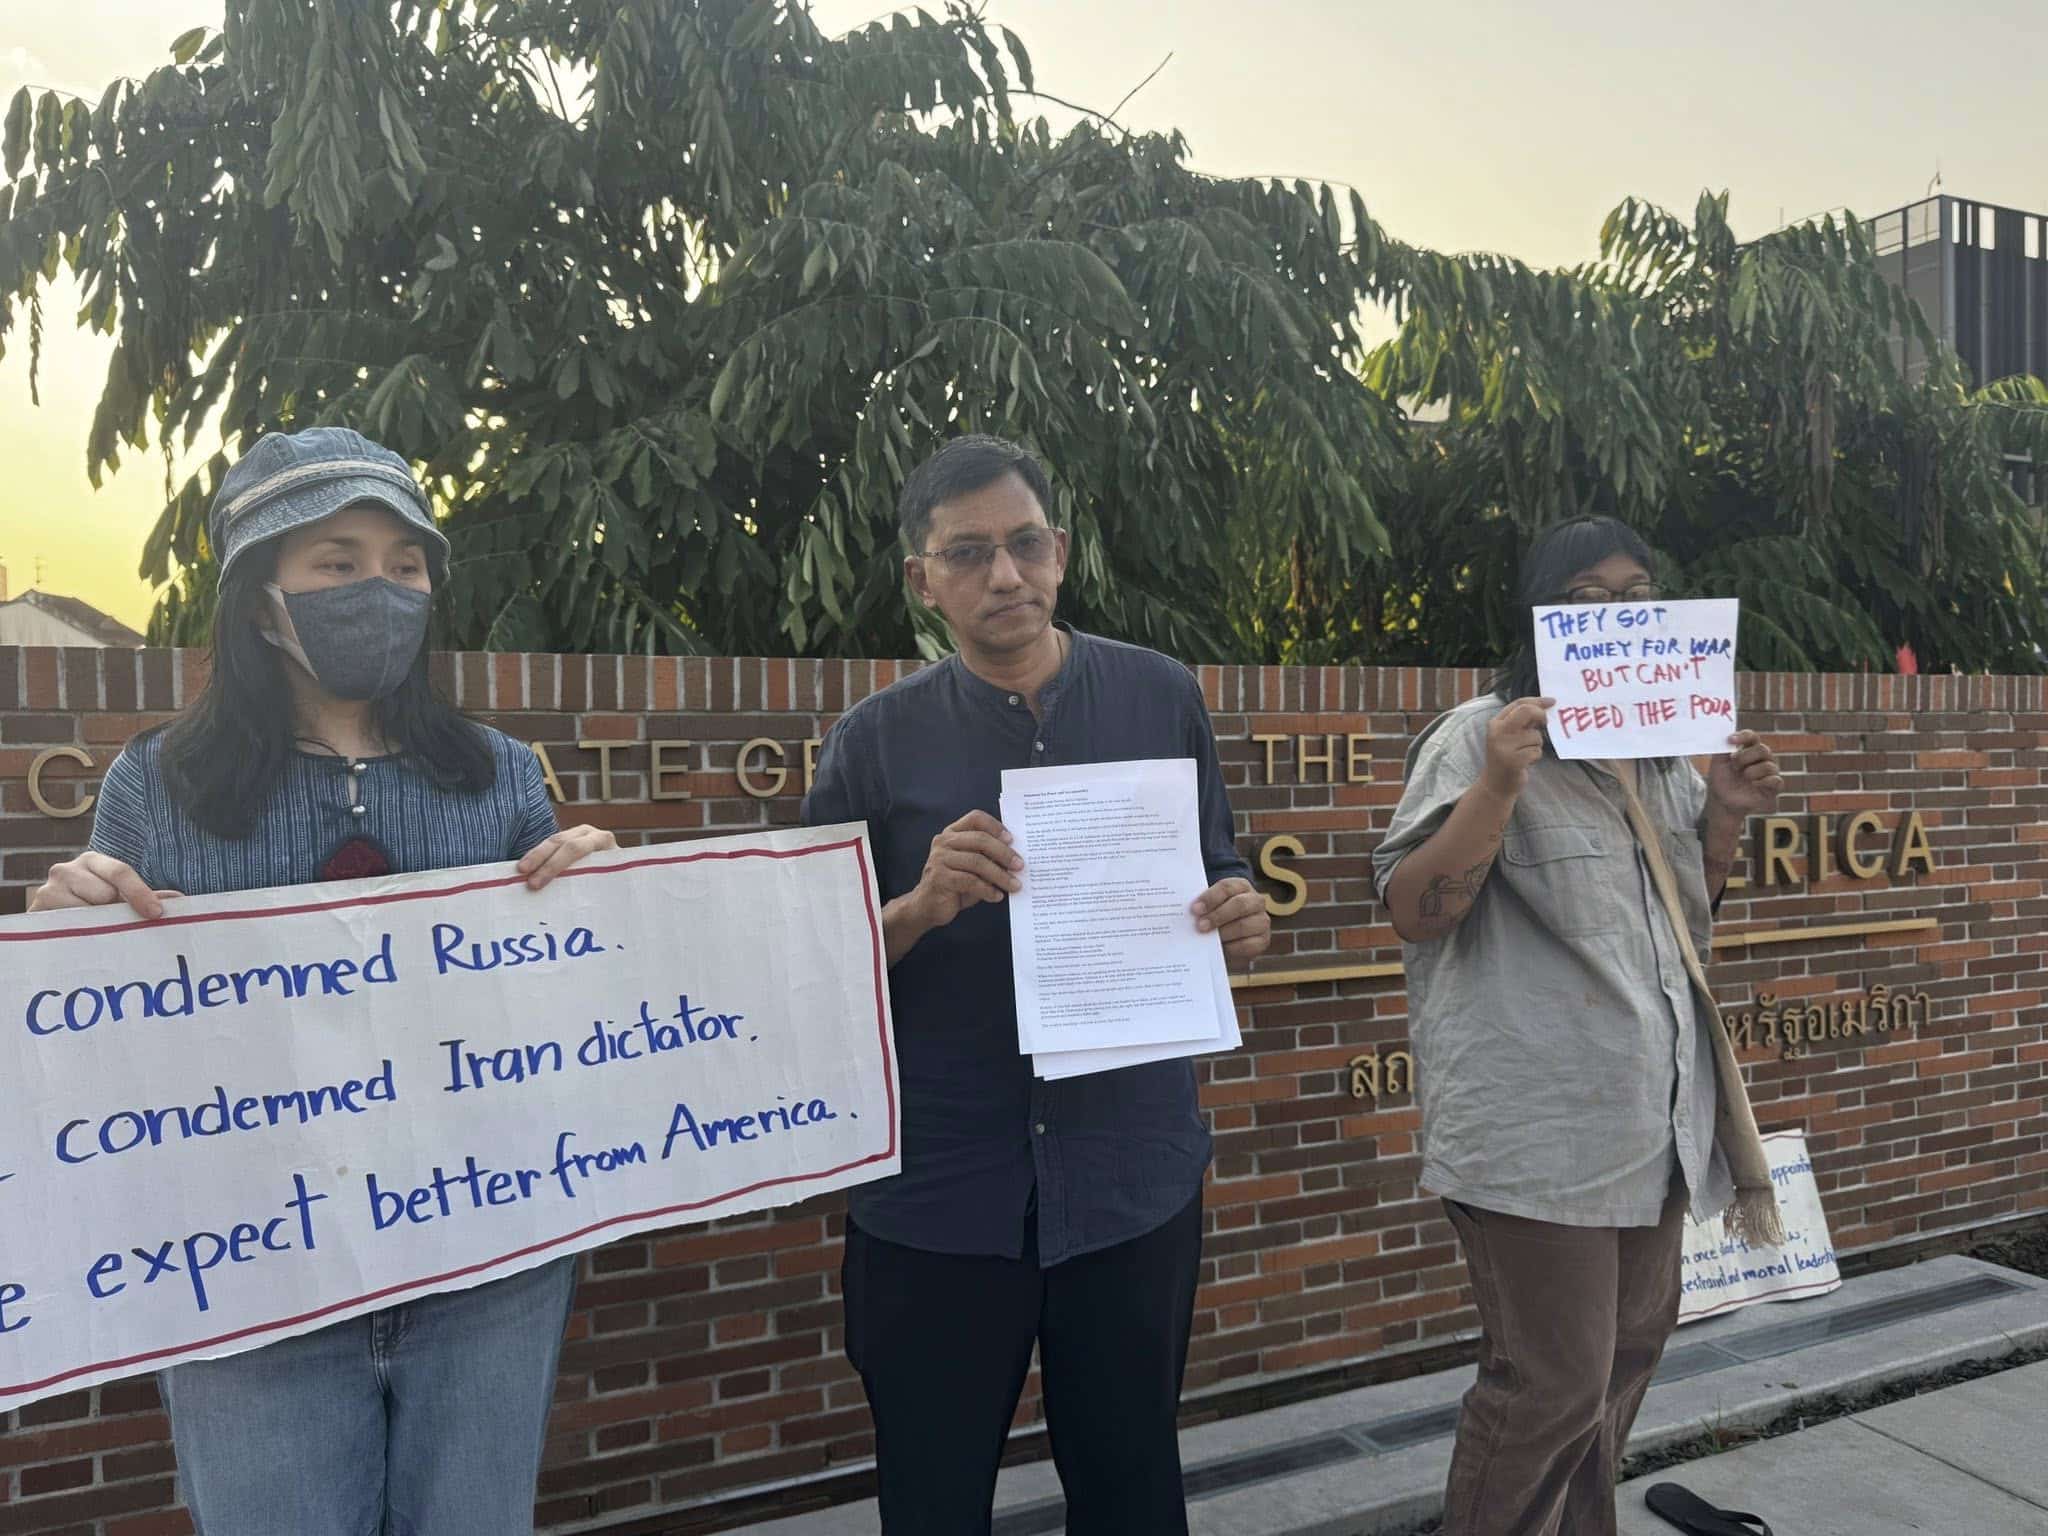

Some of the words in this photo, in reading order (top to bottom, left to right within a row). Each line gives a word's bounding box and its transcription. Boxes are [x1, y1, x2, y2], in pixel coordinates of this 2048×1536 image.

[1540, 607, 1607, 639] THEY
[1564, 640, 1632, 662] MONEY
[1642, 637, 1681, 657] FOR
[1690, 637, 1732, 659] WAR
[1581, 664, 1632, 692] BUT
[1636, 655, 1707, 685] CAN'T
[1557, 704, 1624, 739] FEED
[1633, 698, 1677, 727] THE
[1252, 733, 1376, 785] THE
[26, 934, 398, 1036] condemned
[433, 922, 625, 975] Russia.
[56, 1060, 398, 1165] condemned
[441, 1039, 562, 1093] Iran
[579, 994, 760, 1067] dictator.
[86, 1173, 329, 1313] expect
[366, 1156, 542, 1232] better
[551, 1132, 647, 1199] from
[662, 1092, 860, 1160] America.
[1743, 1254, 1792, 1281] moral
